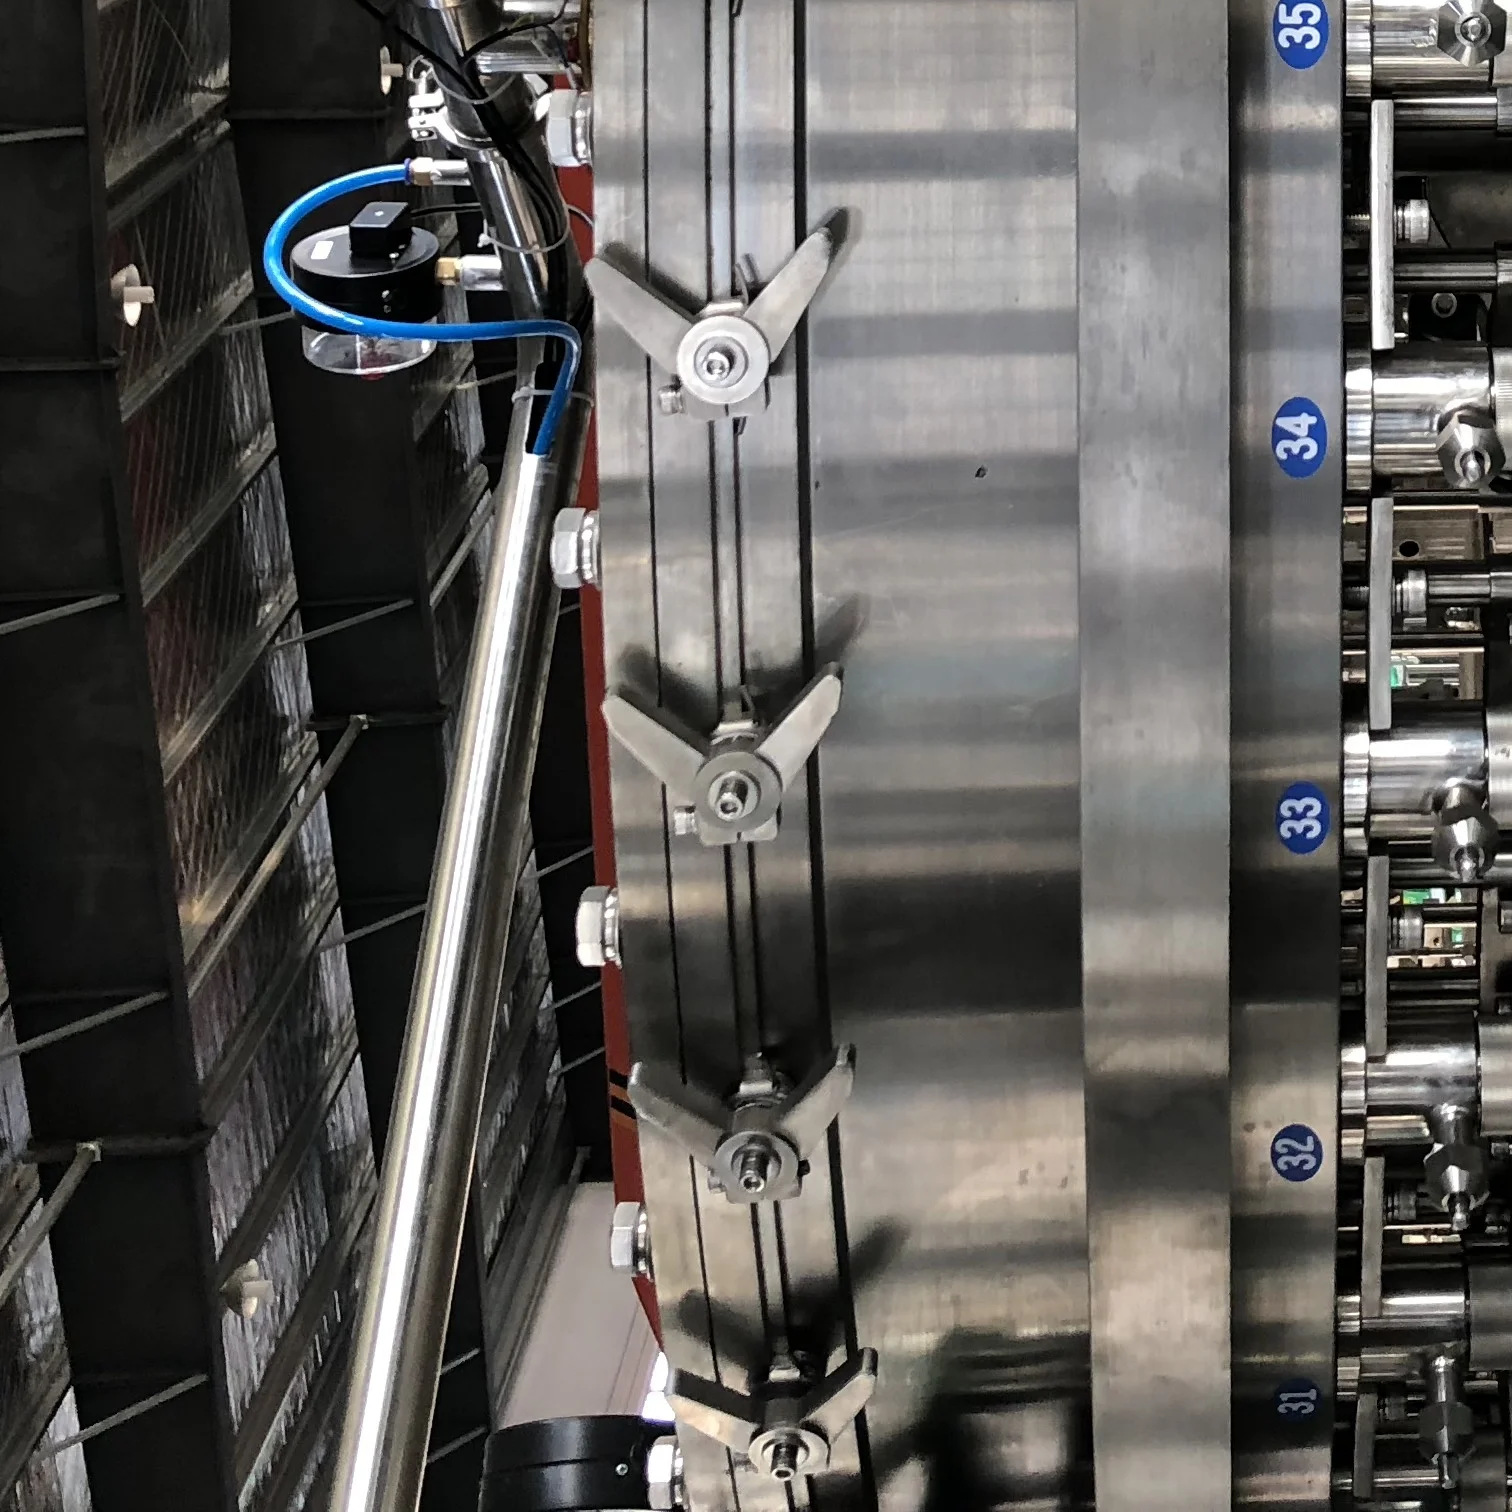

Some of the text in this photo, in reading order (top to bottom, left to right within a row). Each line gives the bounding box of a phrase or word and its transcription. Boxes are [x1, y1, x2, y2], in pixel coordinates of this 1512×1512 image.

[1277, 2, 1321, 50] 35
[1275, 412, 1318, 459] 34
[1279, 796, 1322, 839] 33
[1275, 1134, 1316, 1170] 32
[1277, 1388, 1317, 1414] 31
